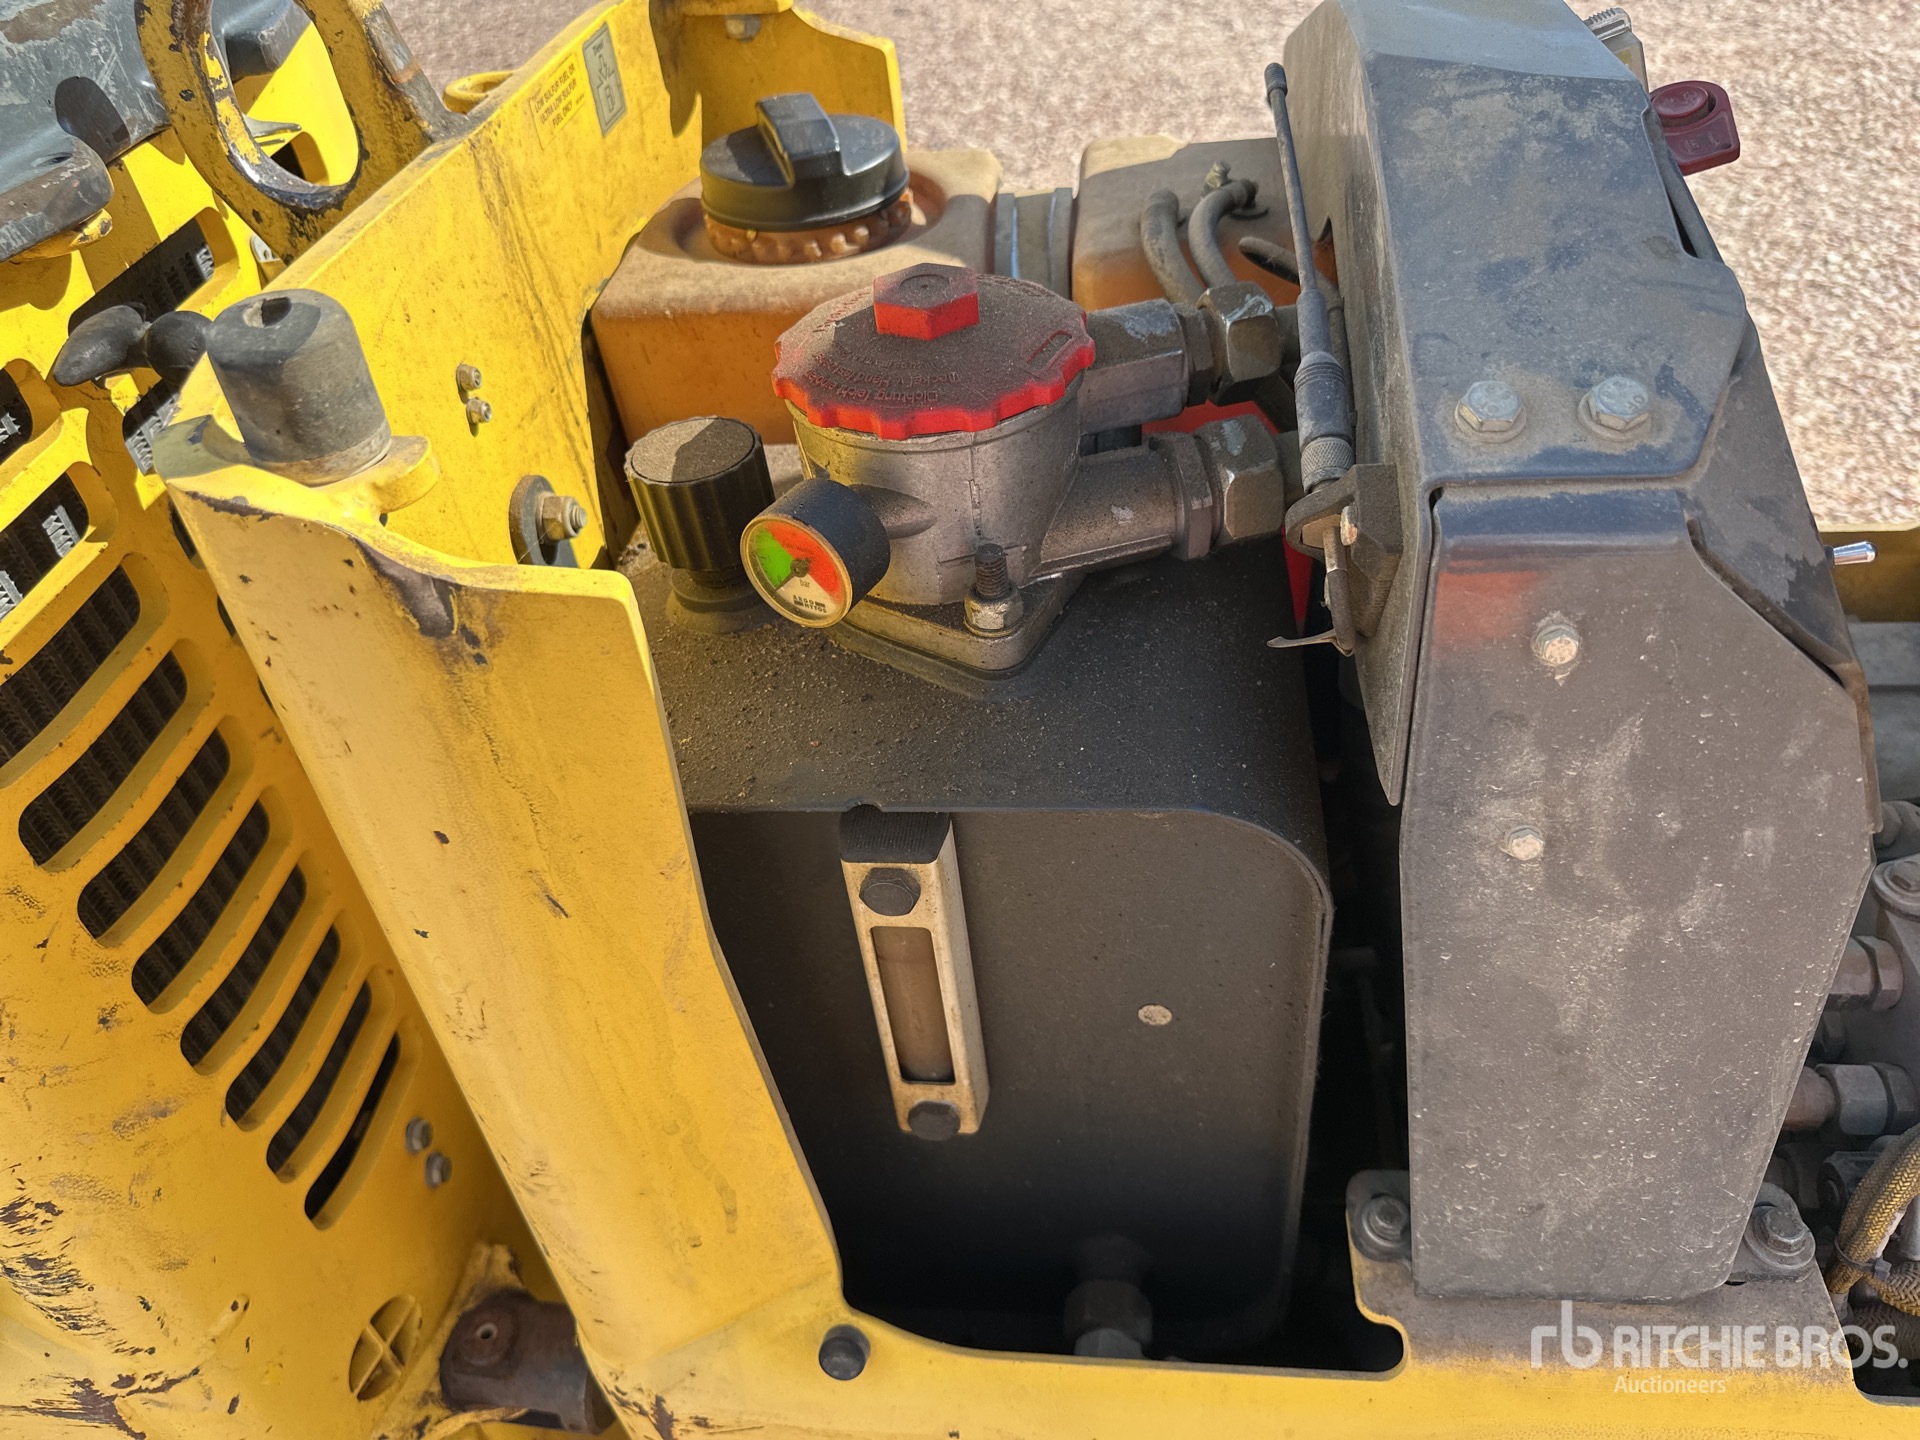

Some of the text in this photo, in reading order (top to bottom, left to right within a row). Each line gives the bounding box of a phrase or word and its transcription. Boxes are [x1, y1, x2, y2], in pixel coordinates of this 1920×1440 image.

[535, 63, 575, 113] LOW SULFUR FUEL OR
[540, 78, 576, 125] ULTRA LOW SULFUR
[552, 113, 564, 129] FUEL
[799, 578, 810, 588] bar
[793, 594, 814, 605] ARGO
